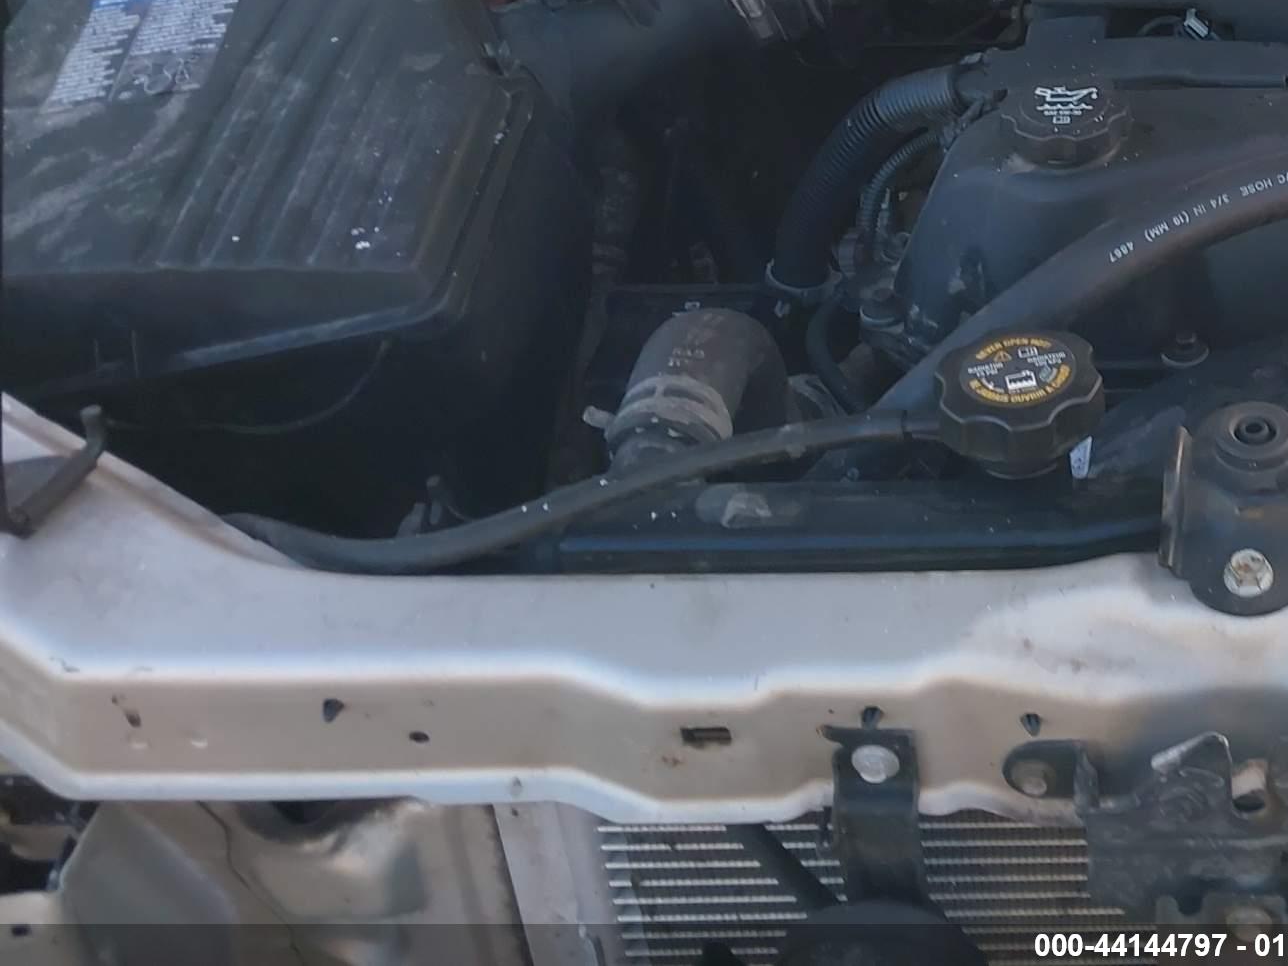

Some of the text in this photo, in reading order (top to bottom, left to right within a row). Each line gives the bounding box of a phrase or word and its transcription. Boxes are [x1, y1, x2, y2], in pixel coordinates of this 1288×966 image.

[1239, 177, 1273, 197] HOSE
[1209, 192, 1231, 209] 3/4
[1192, 203, 1207, 217] IN
[1143, 221, 1170, 243] MM)
[1002, 337, 1029, 348] OPEN
